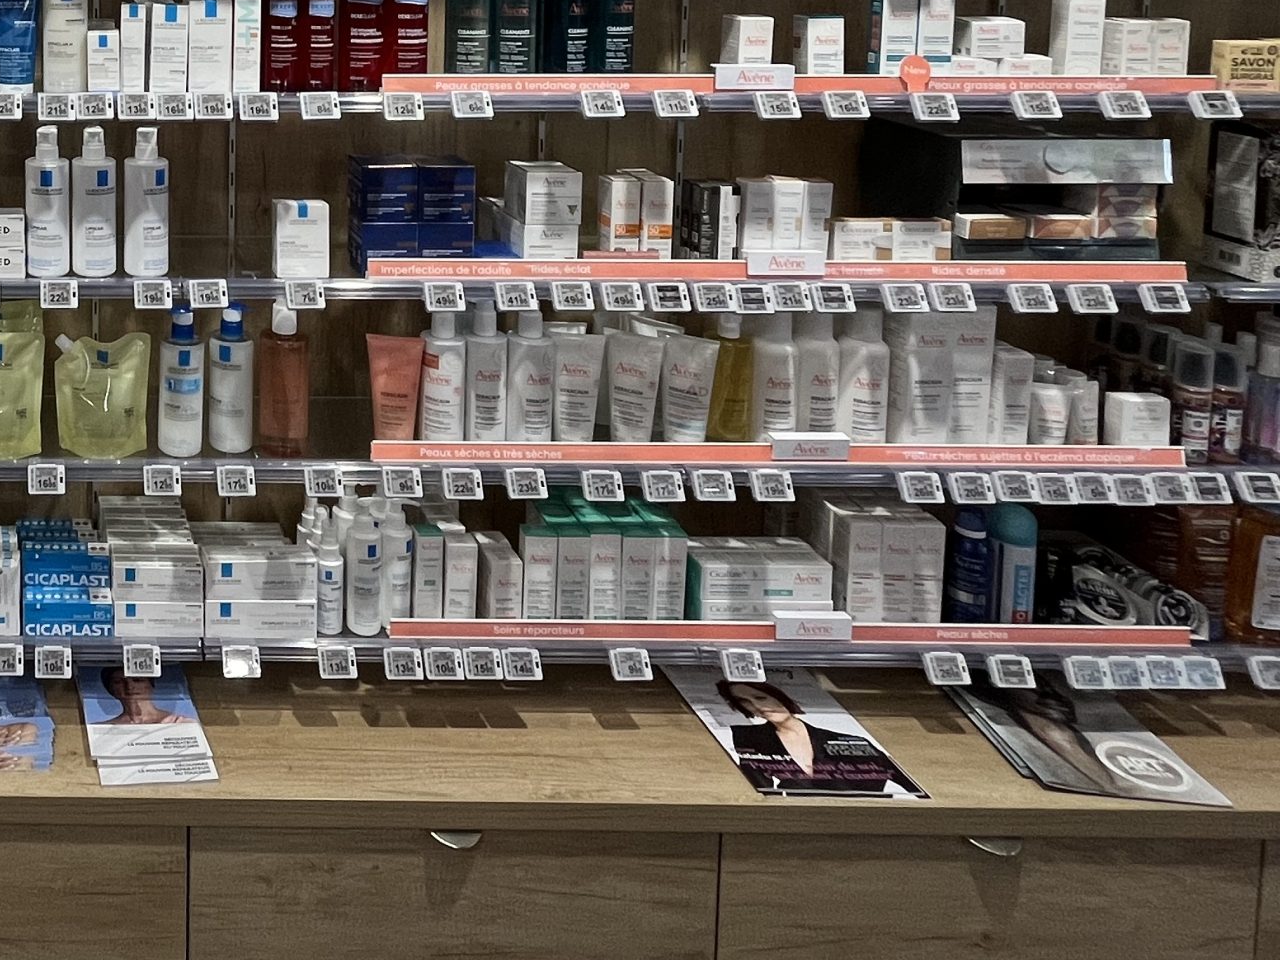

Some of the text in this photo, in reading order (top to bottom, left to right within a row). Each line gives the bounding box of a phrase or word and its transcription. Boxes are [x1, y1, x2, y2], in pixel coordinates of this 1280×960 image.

[1231, 57, 1276, 67] SAVON
[737, 70, 775, 83] Avène
[436, 81, 468, 91] Peaux
[525, 80, 575, 90] tendance
[768, 256, 806, 269] Avène
[381, 265, 455, 277] Imperfections
[458, 265, 470, 275] de
[420, 448, 452, 458] Peaux
[454, 447, 489, 458] sèches
[503, 447, 523, 458] très
[526, 447, 562, 458] sèches
[24, 572, 109, 587] CICAPLAST
[25, 623, 112, 637] CICAPLAST
[493, 625, 520, 634] Soins
